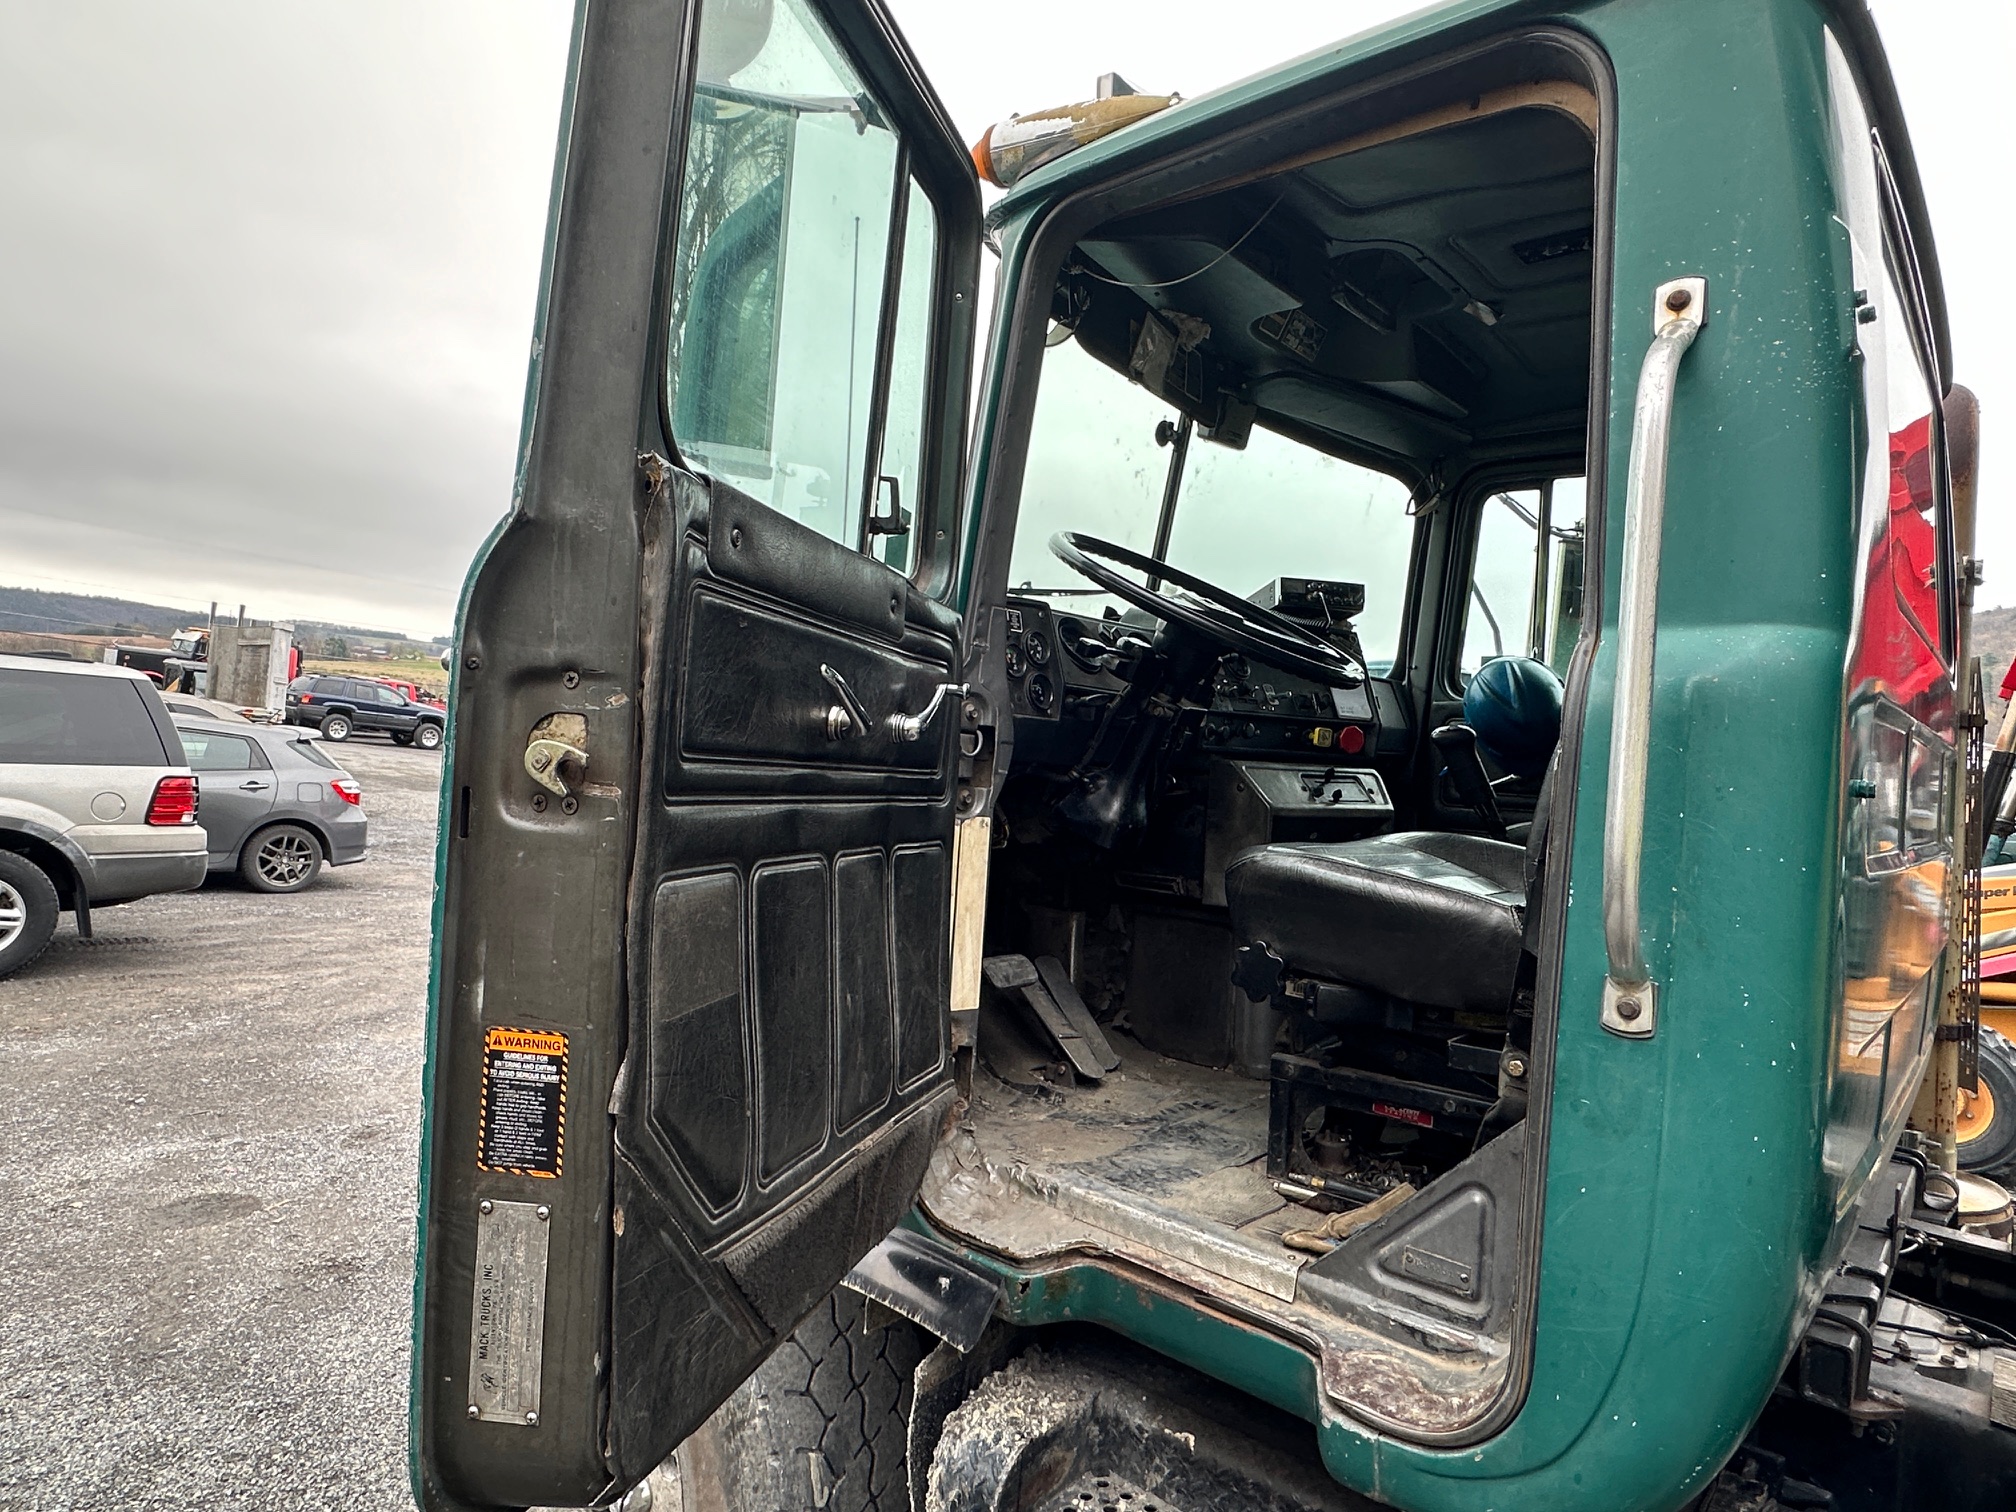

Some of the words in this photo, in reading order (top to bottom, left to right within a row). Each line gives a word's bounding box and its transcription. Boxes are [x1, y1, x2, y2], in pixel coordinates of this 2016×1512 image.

[504, 1036, 561, 1051] WARNING
[503, 1051, 536, 1061] GUIDELINES
[494, 1060, 521, 1069] ENTERING
[522, 1063, 535, 1071] AND
[535, 1064, 557, 1073] EXITING
[490, 1068, 498, 1076] TO
[498, 1069, 515, 1078] AVOID
[515, 1071, 540, 1080] SERIOUS
[540, 1073, 560, 1082] INJURY
[479, 1332, 489, 1360] MACK
